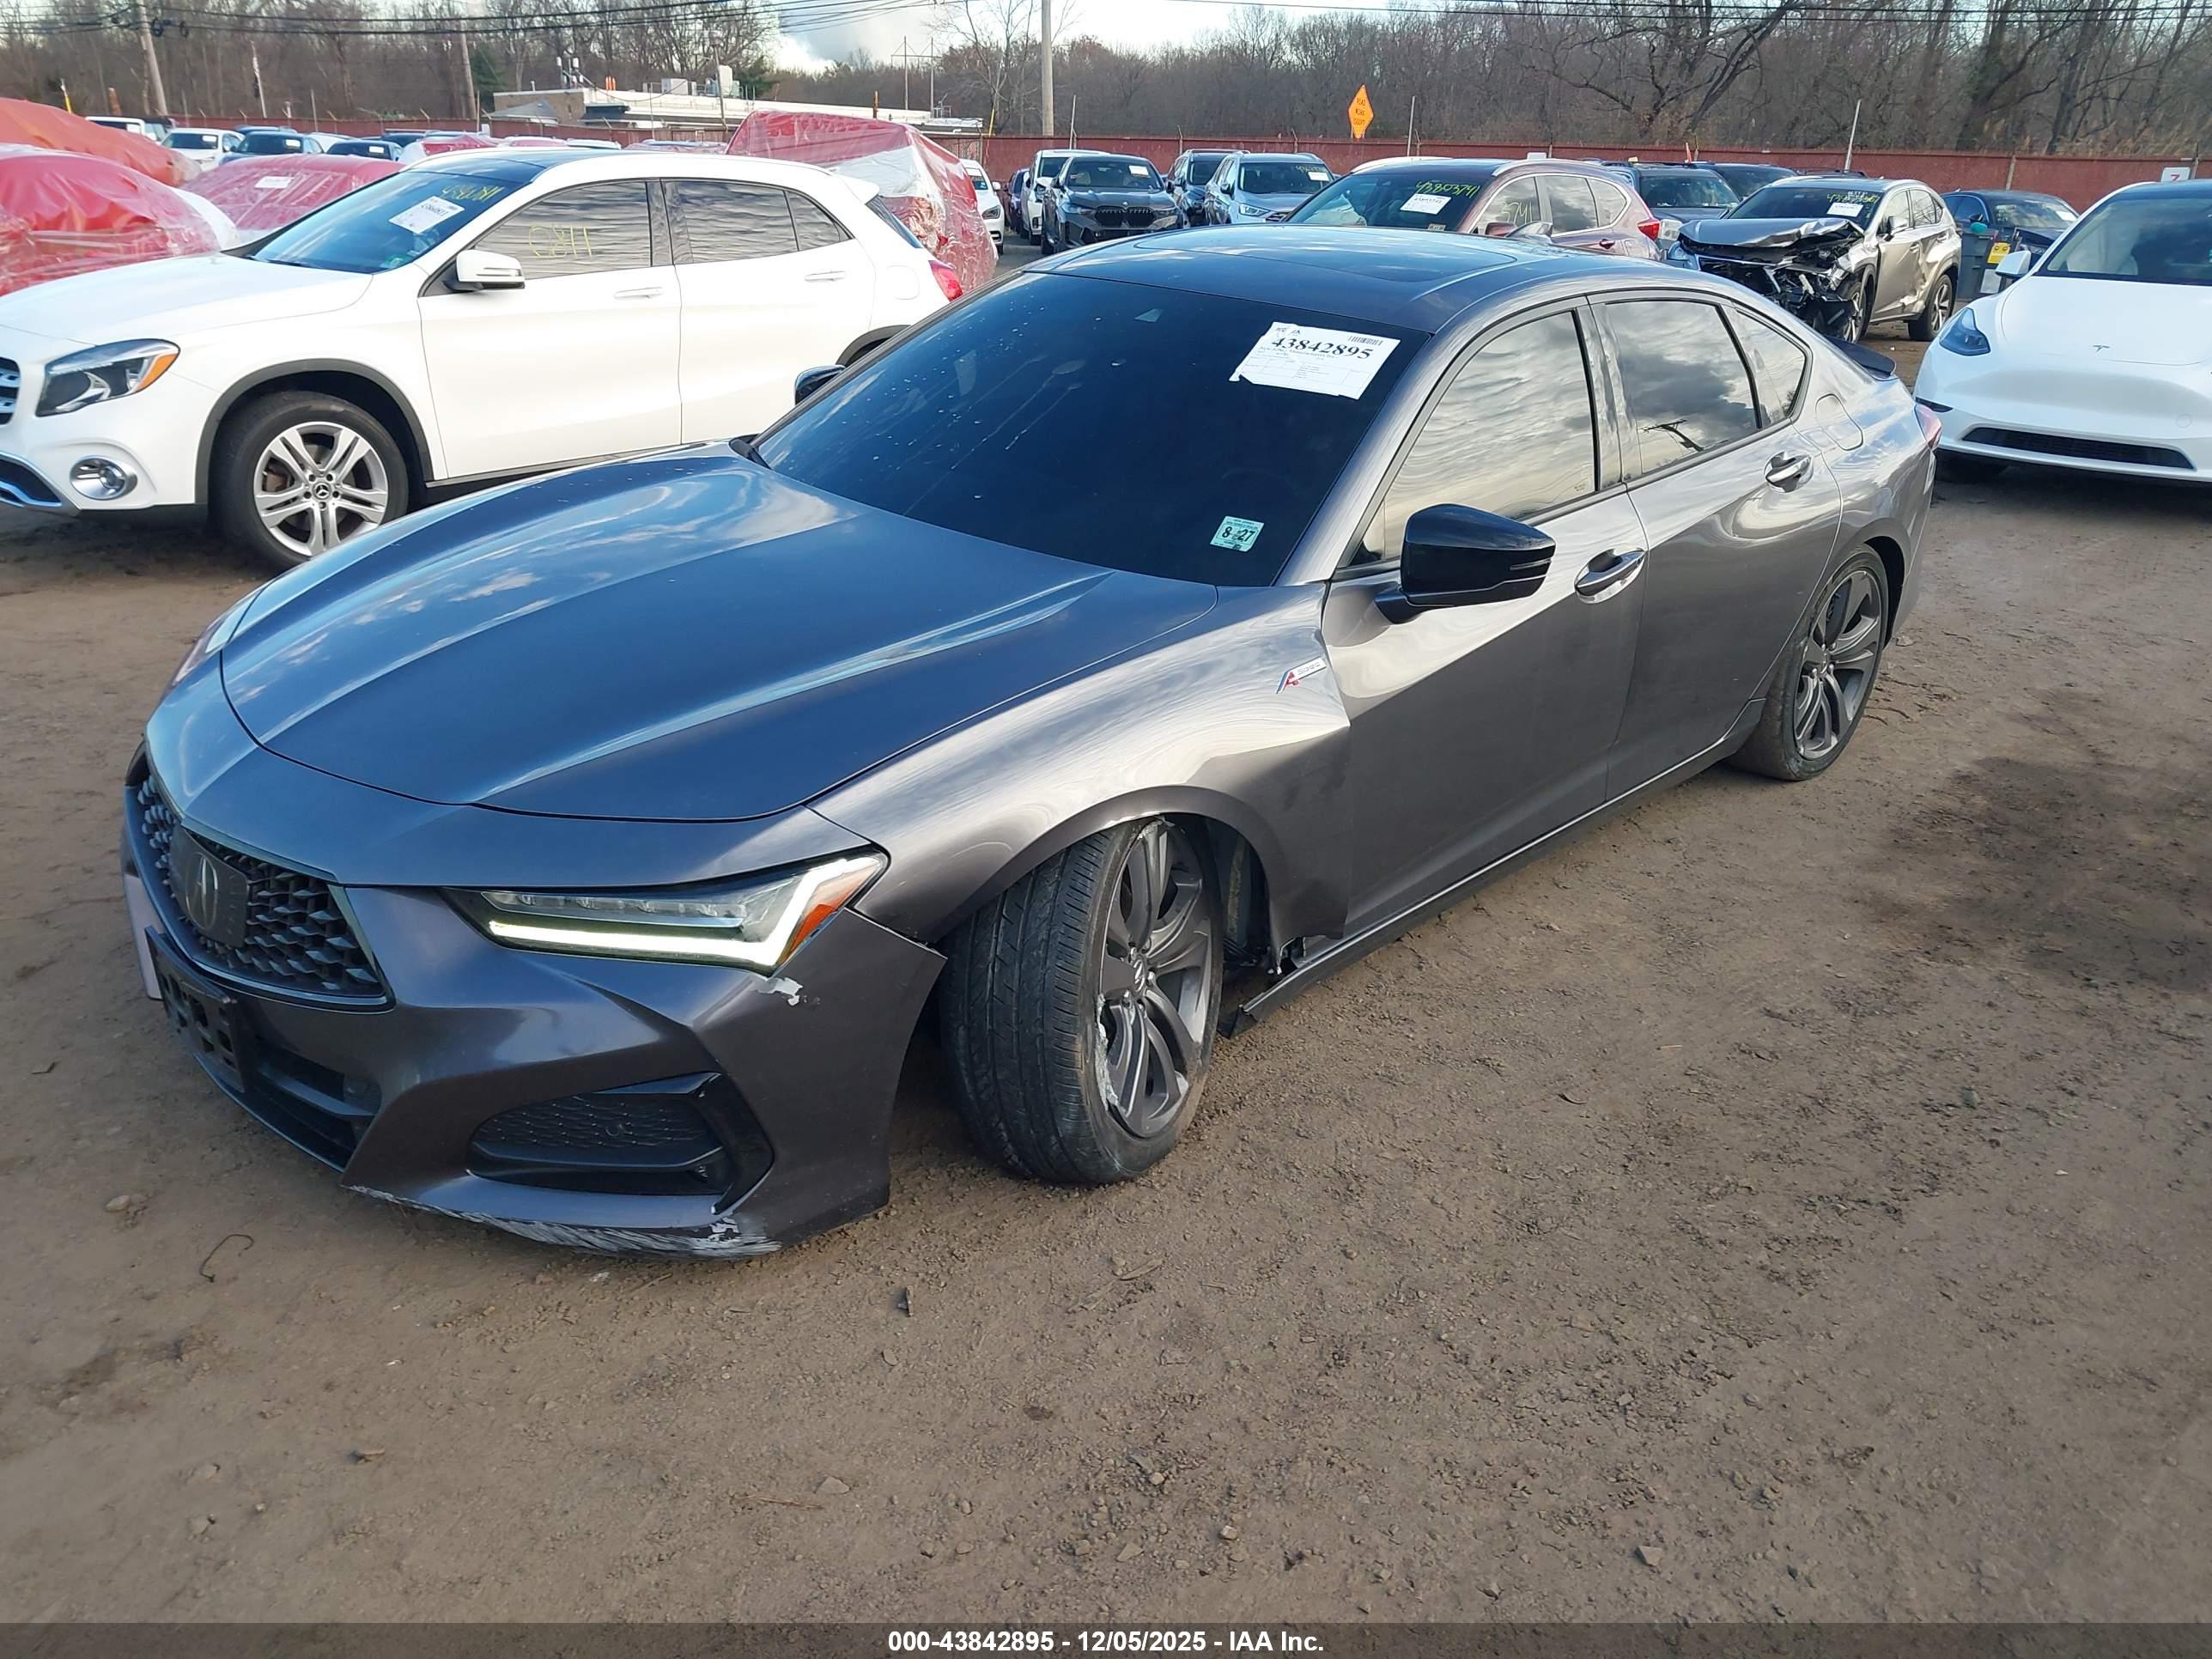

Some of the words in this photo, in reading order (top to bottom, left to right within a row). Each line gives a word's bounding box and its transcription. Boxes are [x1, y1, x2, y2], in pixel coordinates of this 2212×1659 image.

[1415, 181, 1480, 199] 43803741
[1271, 337, 1374, 360] 43842895
[1222, 526, 1233, 538] 8
[1237, 529, 1256, 542] 27
